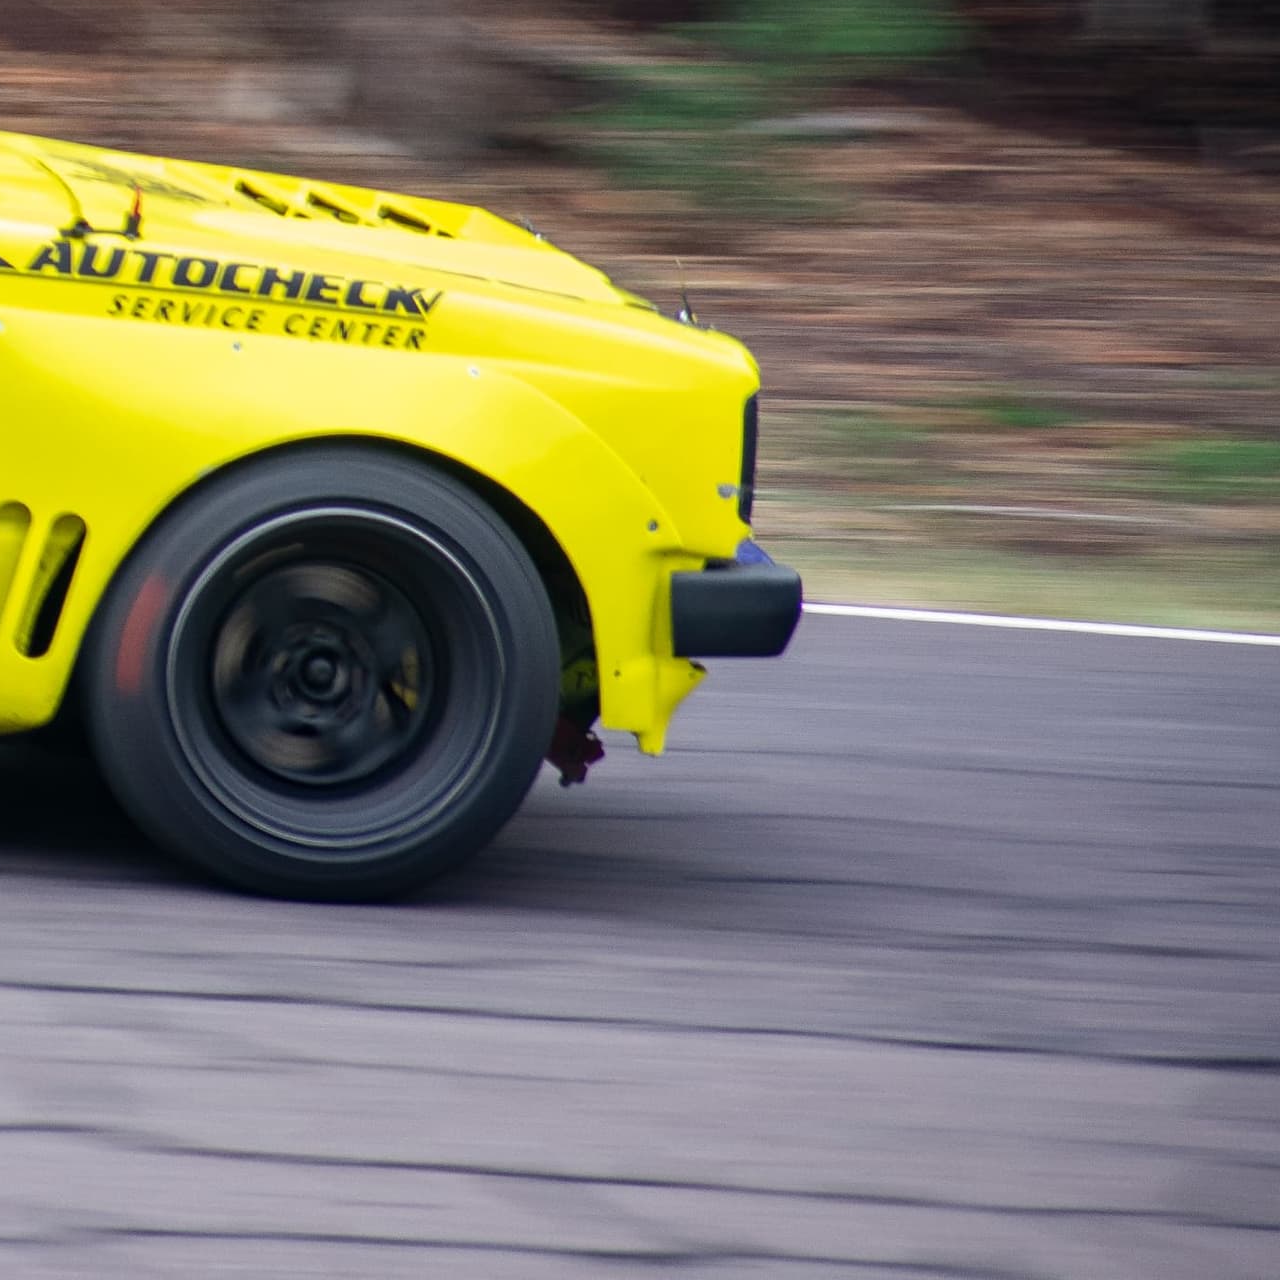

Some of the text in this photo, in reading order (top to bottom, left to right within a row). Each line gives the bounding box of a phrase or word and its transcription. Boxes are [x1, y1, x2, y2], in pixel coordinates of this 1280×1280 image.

[28, 240, 427, 317] AUTOCHECK
[107, 293, 428, 352] SERVICE CENTER
